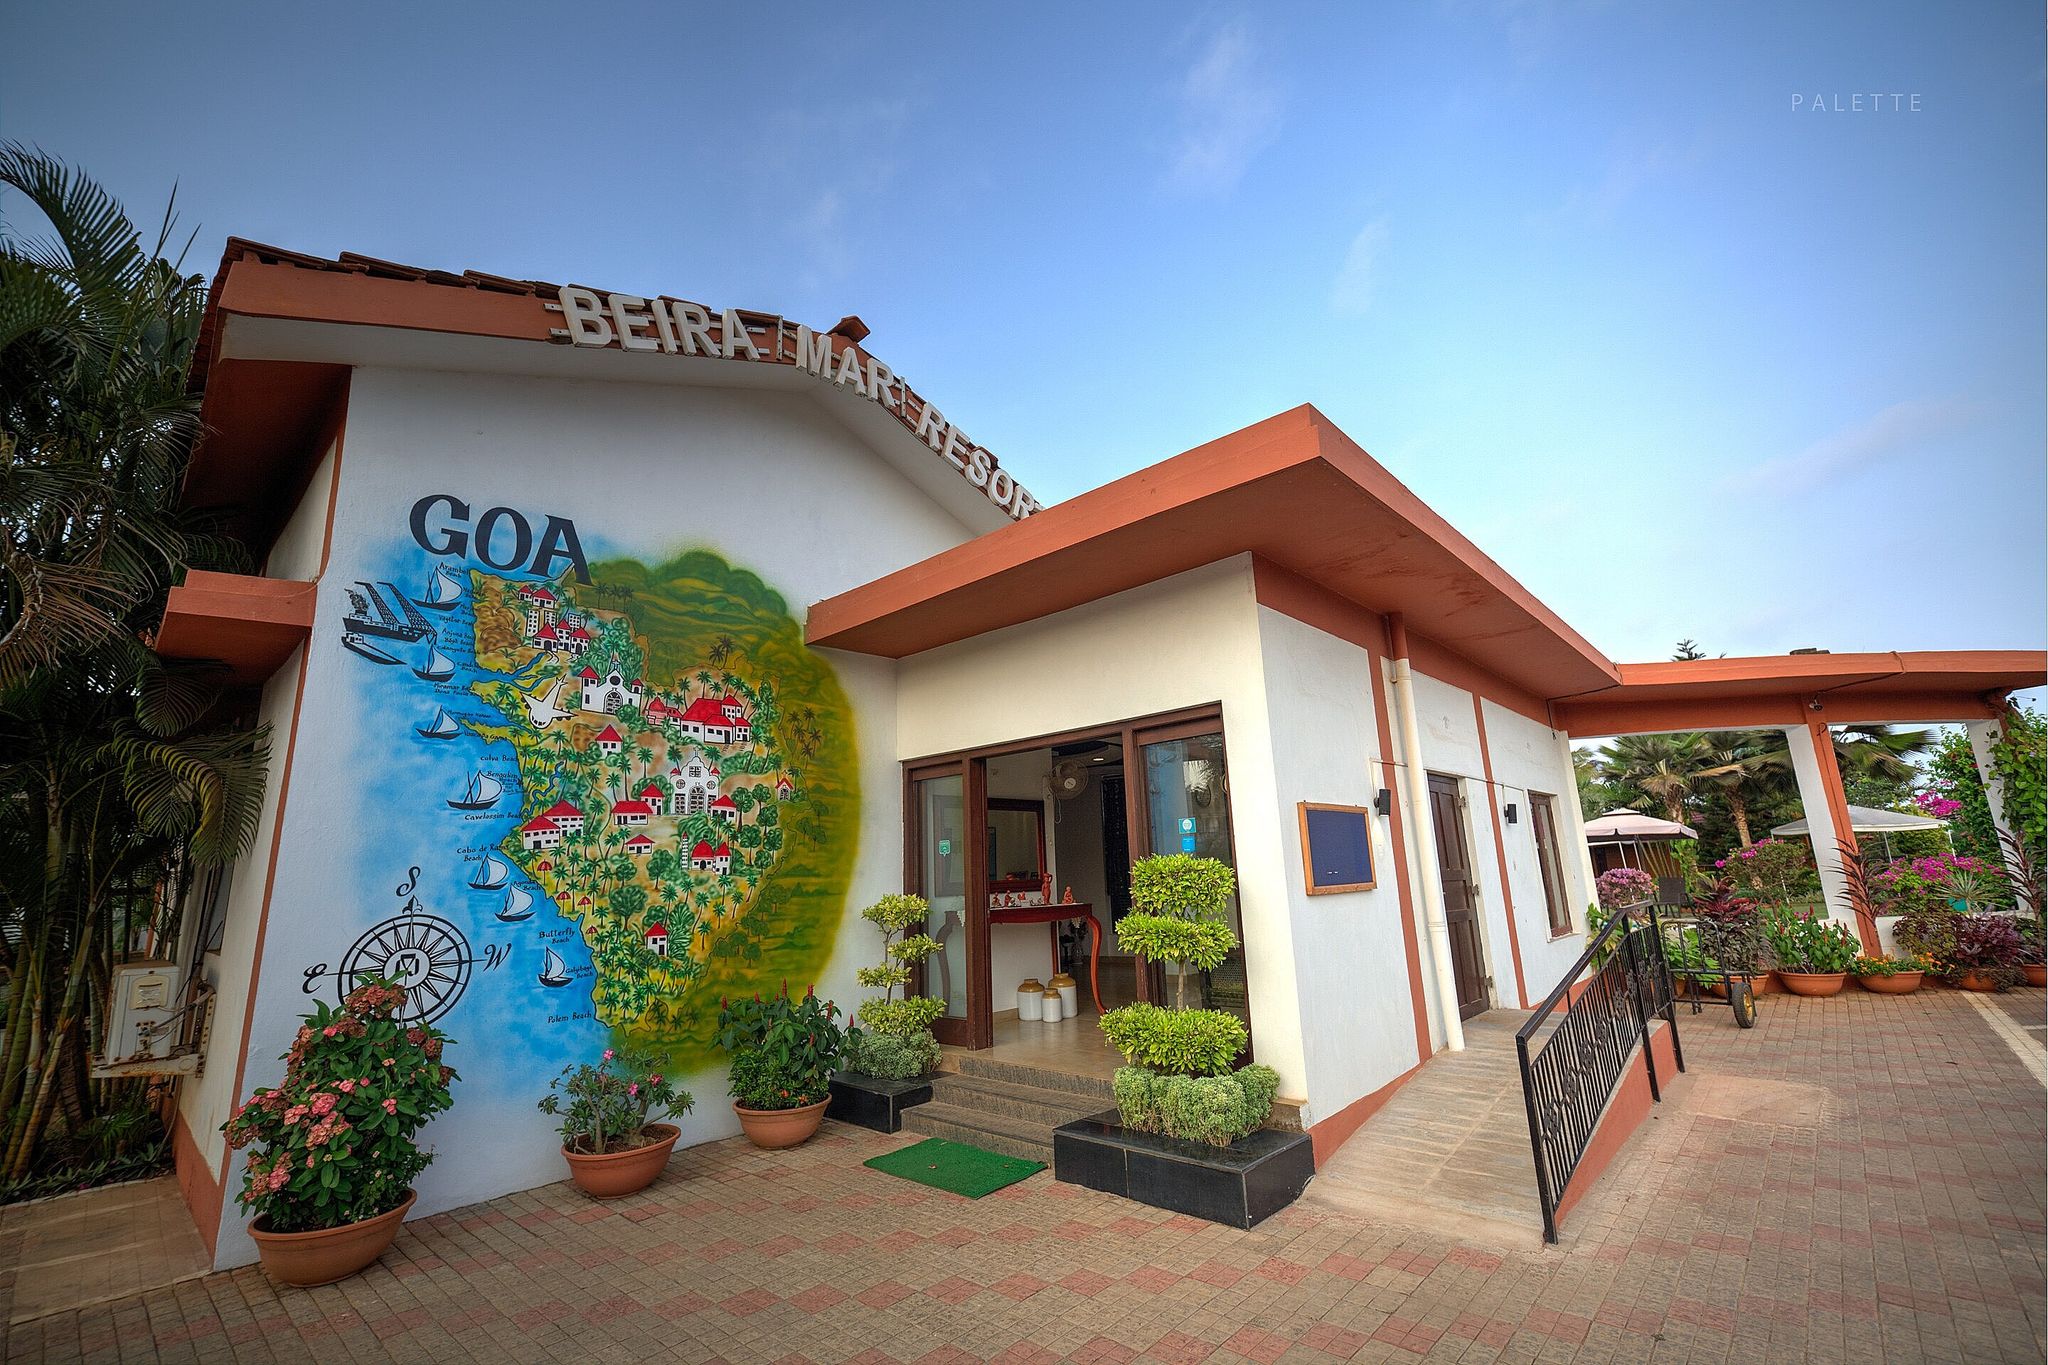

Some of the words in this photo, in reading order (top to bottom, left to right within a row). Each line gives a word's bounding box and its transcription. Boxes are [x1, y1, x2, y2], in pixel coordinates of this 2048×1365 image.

[558, 285, 761, 362] BEIRA
[795, 323, 898, 410] MAR
[915, 401, 1044, 521] RESOR
[409, 494, 594, 586] GOA
[396, 866, 420, 896] S
[539, 927, 576, 939] Butterfly
